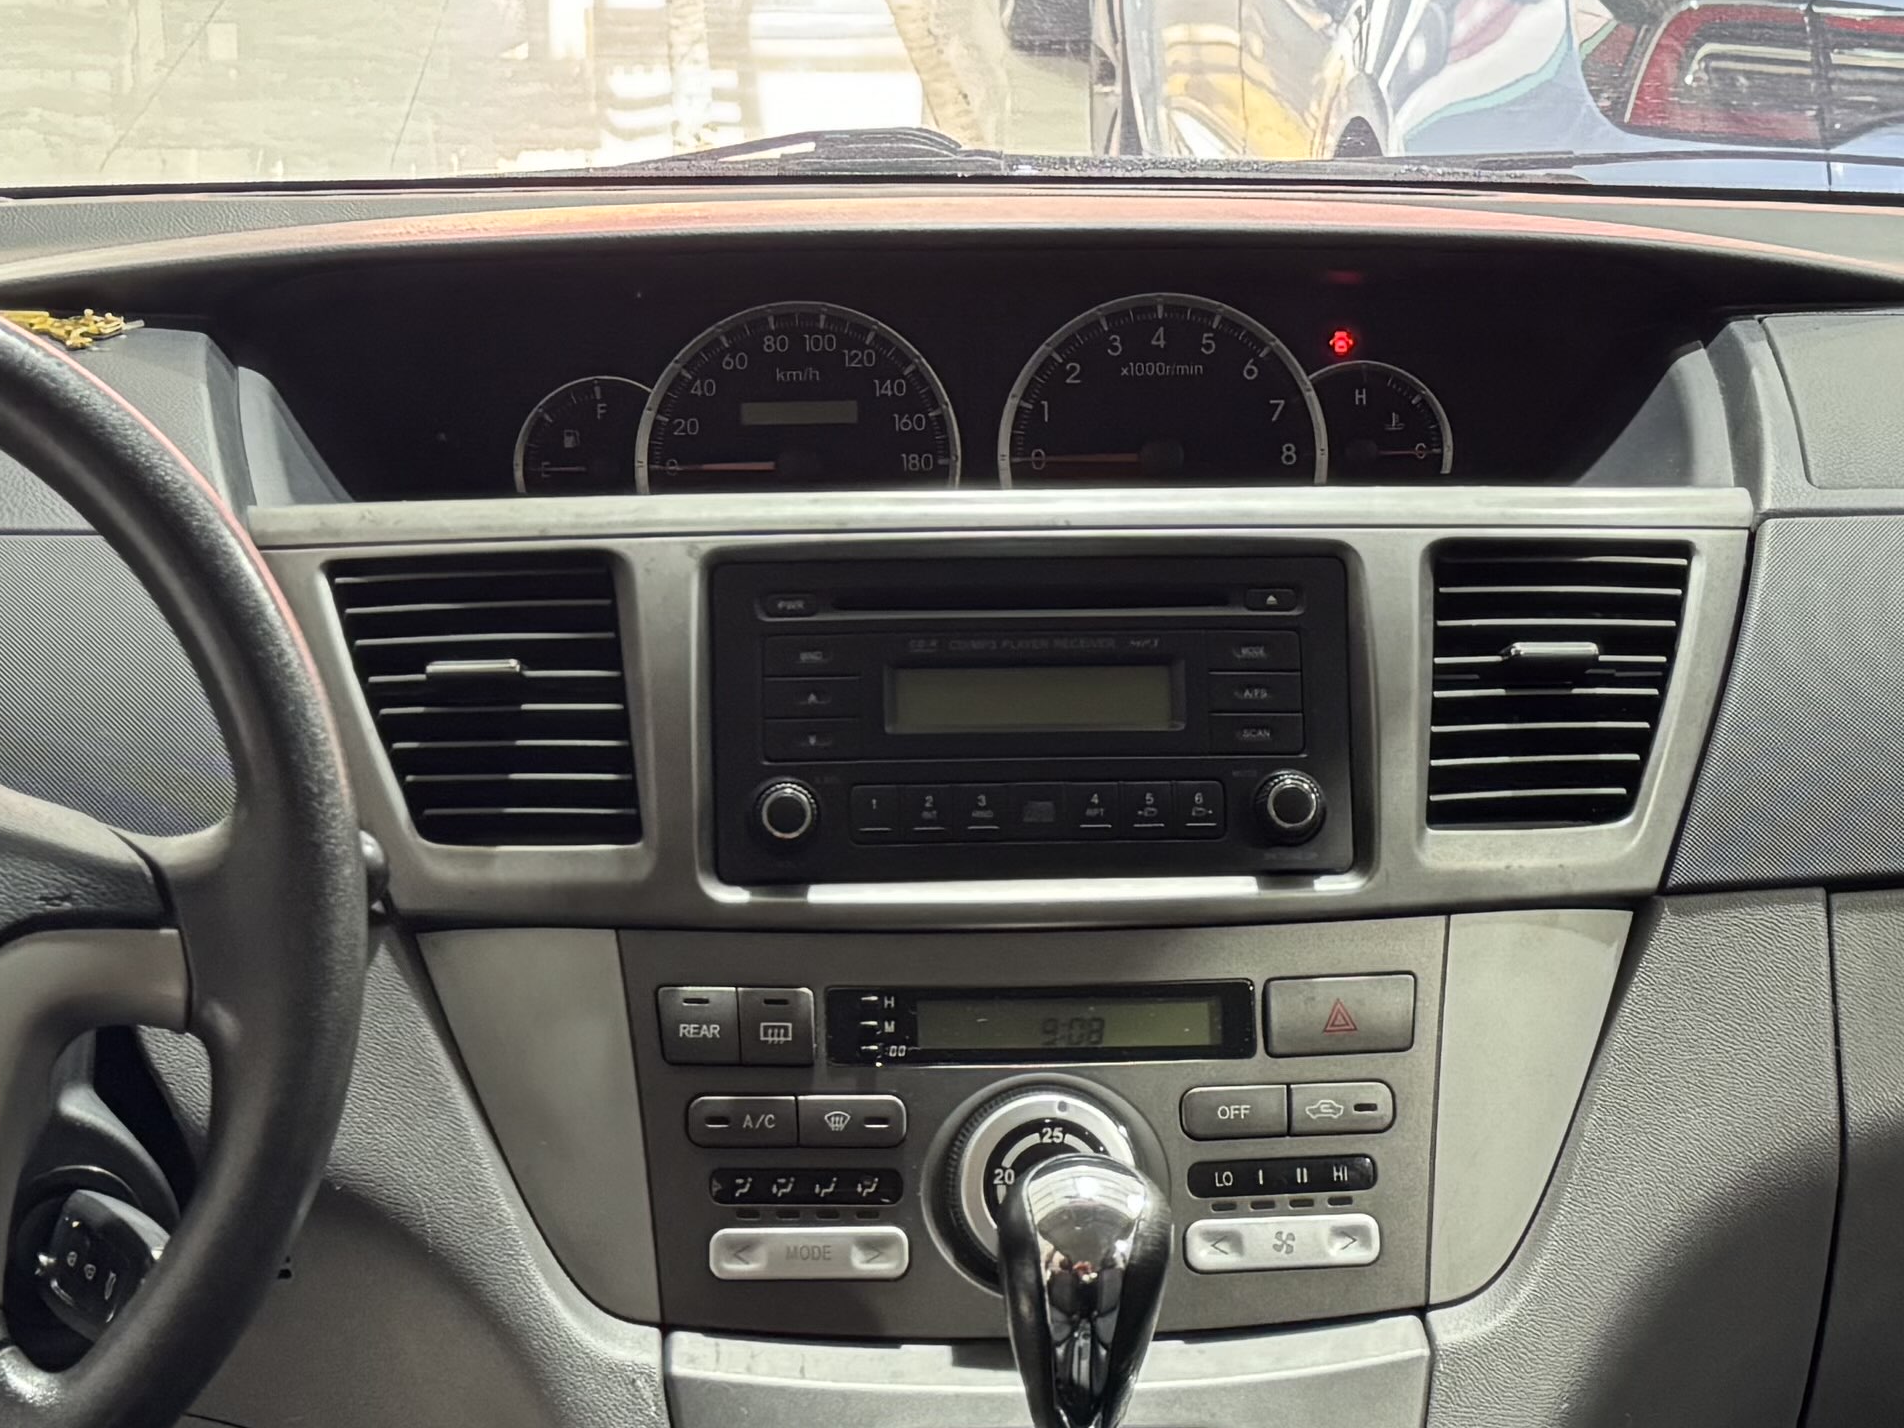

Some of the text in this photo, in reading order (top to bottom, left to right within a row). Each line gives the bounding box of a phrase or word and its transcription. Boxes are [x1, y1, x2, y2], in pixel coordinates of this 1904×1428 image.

[763, 335, 790, 353] 80
[803, 334, 837, 353] 100
[1107, 335, 1123, 357] 3
[1150, 326, 1167, 349] 4
[1200, 334, 1217, 356] 5
[722, 352, 749, 370] 60
[843, 349, 877, 368] 120
[776, 367, 820, 381] km/h
[1065, 363, 1082, 384] 2
[1242, 360, 1258, 381] 6
[691, 378, 717, 397] 40
[873, 379, 907, 397] 140
[1354, 389, 1367, 406] H
[596, 403, 610, 420] F
[1040, 400, 1049, 422] 1
[1269, 400, 1286, 422] 7
[673, 419, 700, 436] 20
[892, 414, 927, 432] 160
[900, 454, 934, 472] 180
[1030, 449, 1045, 471] 0
[1280, 444, 1297, 466] 8
[871, 798, 878, 810] 1
[924, 795, 934, 807] 2
[977, 794, 987, 807] 3
[1090, 793, 1099, 805] 4
[1144, 792, 1154, 805] 5
[1194, 792, 1203, 805] 6
[883, 995, 895, 1009] H
[679, 1023, 721, 1039] REAR
[883, 1020, 895, 1033] M
[1042, 1017, 1105, 1046] 9:08
[1217, 1105, 1251, 1120] OFF
[742, 1114, 776, 1129] A/C
[1041, 1127, 1064, 1144] 25
[993, 1168, 1015, 1185] 20
[1214, 1171, 1234, 1188] LO
[1333, 1165, 1348, 1182] HI
[785, 1244, 833, 1261] MODE
